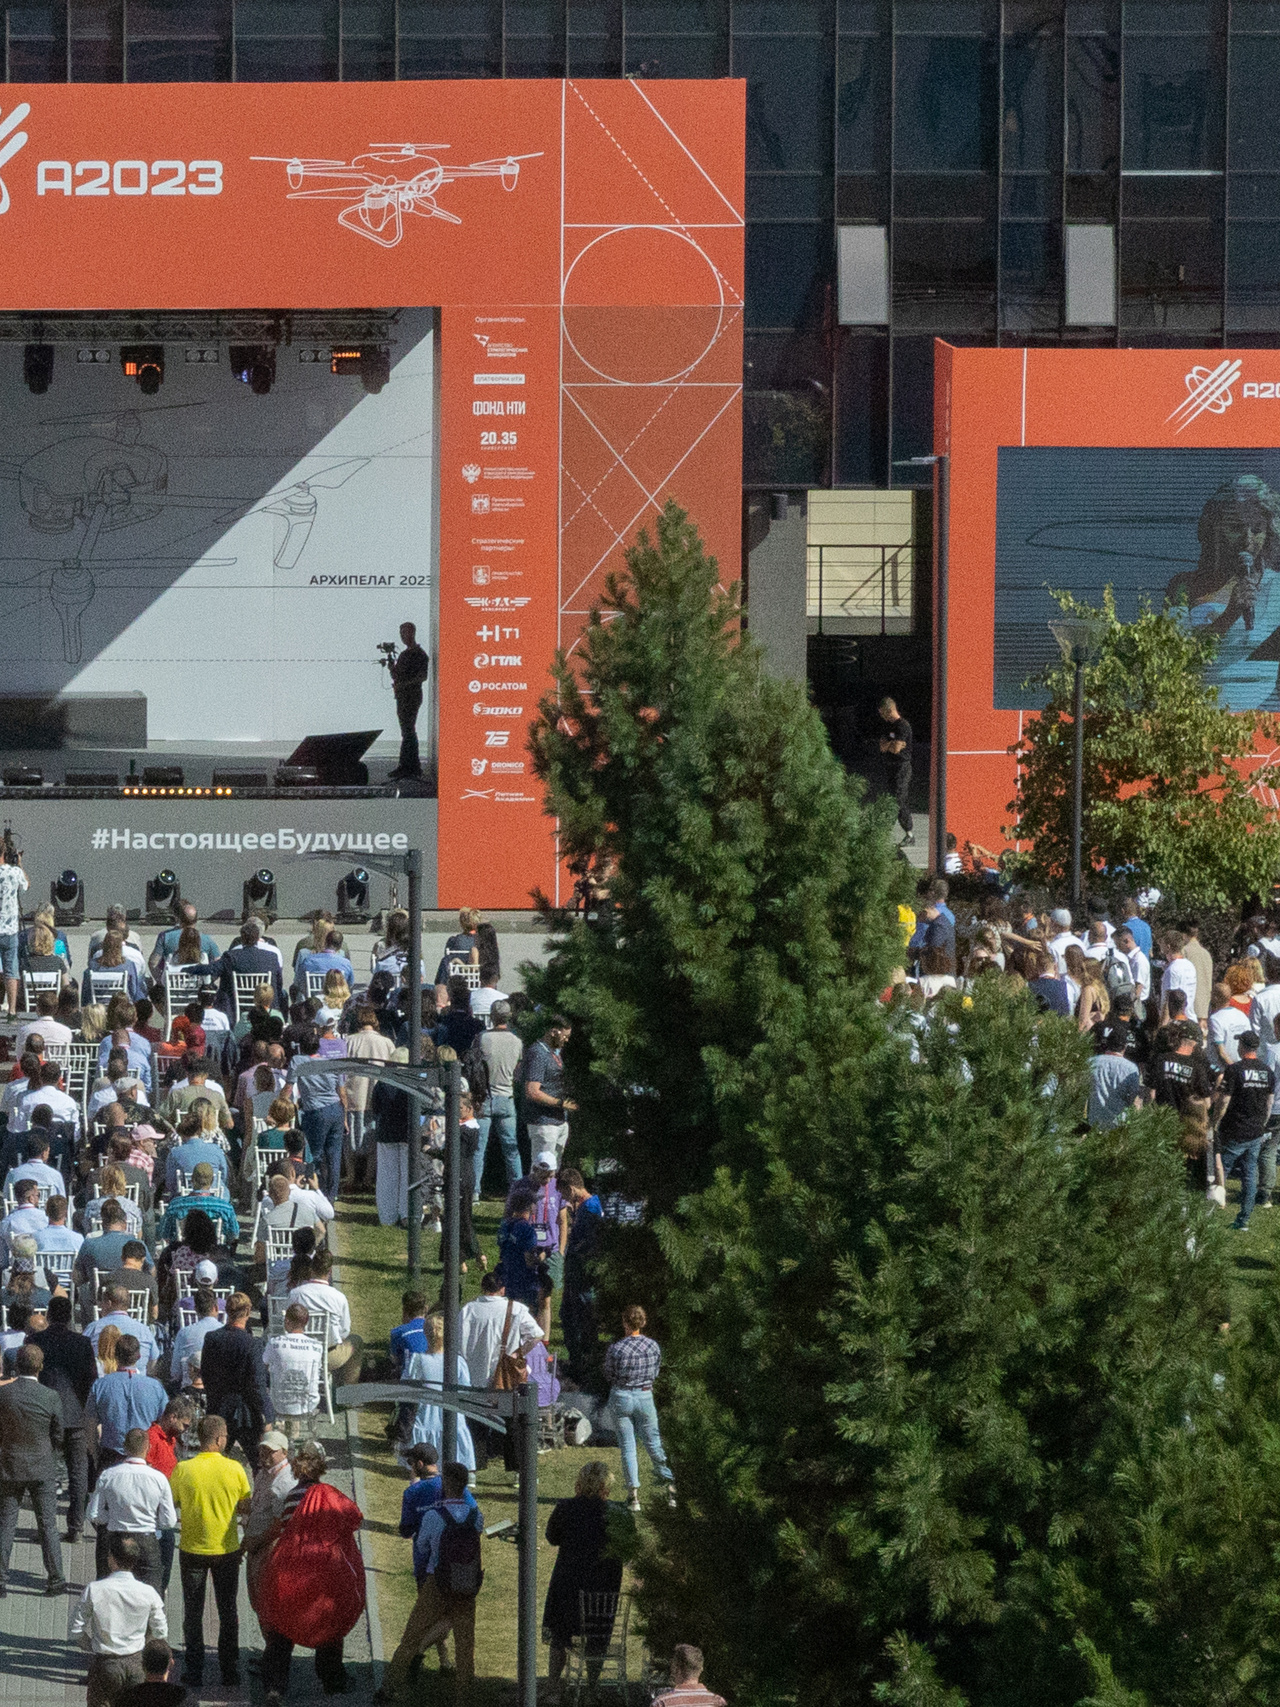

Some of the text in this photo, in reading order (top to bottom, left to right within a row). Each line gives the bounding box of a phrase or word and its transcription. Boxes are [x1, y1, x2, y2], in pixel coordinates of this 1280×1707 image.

[472, 401, 526, 417] ФОНД НТИ
[480, 431, 517, 445] 20.35
[310, 575, 395, 586] АРХИПЕЛАГ
[491, 655, 522, 666] ГТЛК
[482, 682, 527, 690] РОСАТОМ
[91, 828, 408, 854] #НастоящееБудущее
